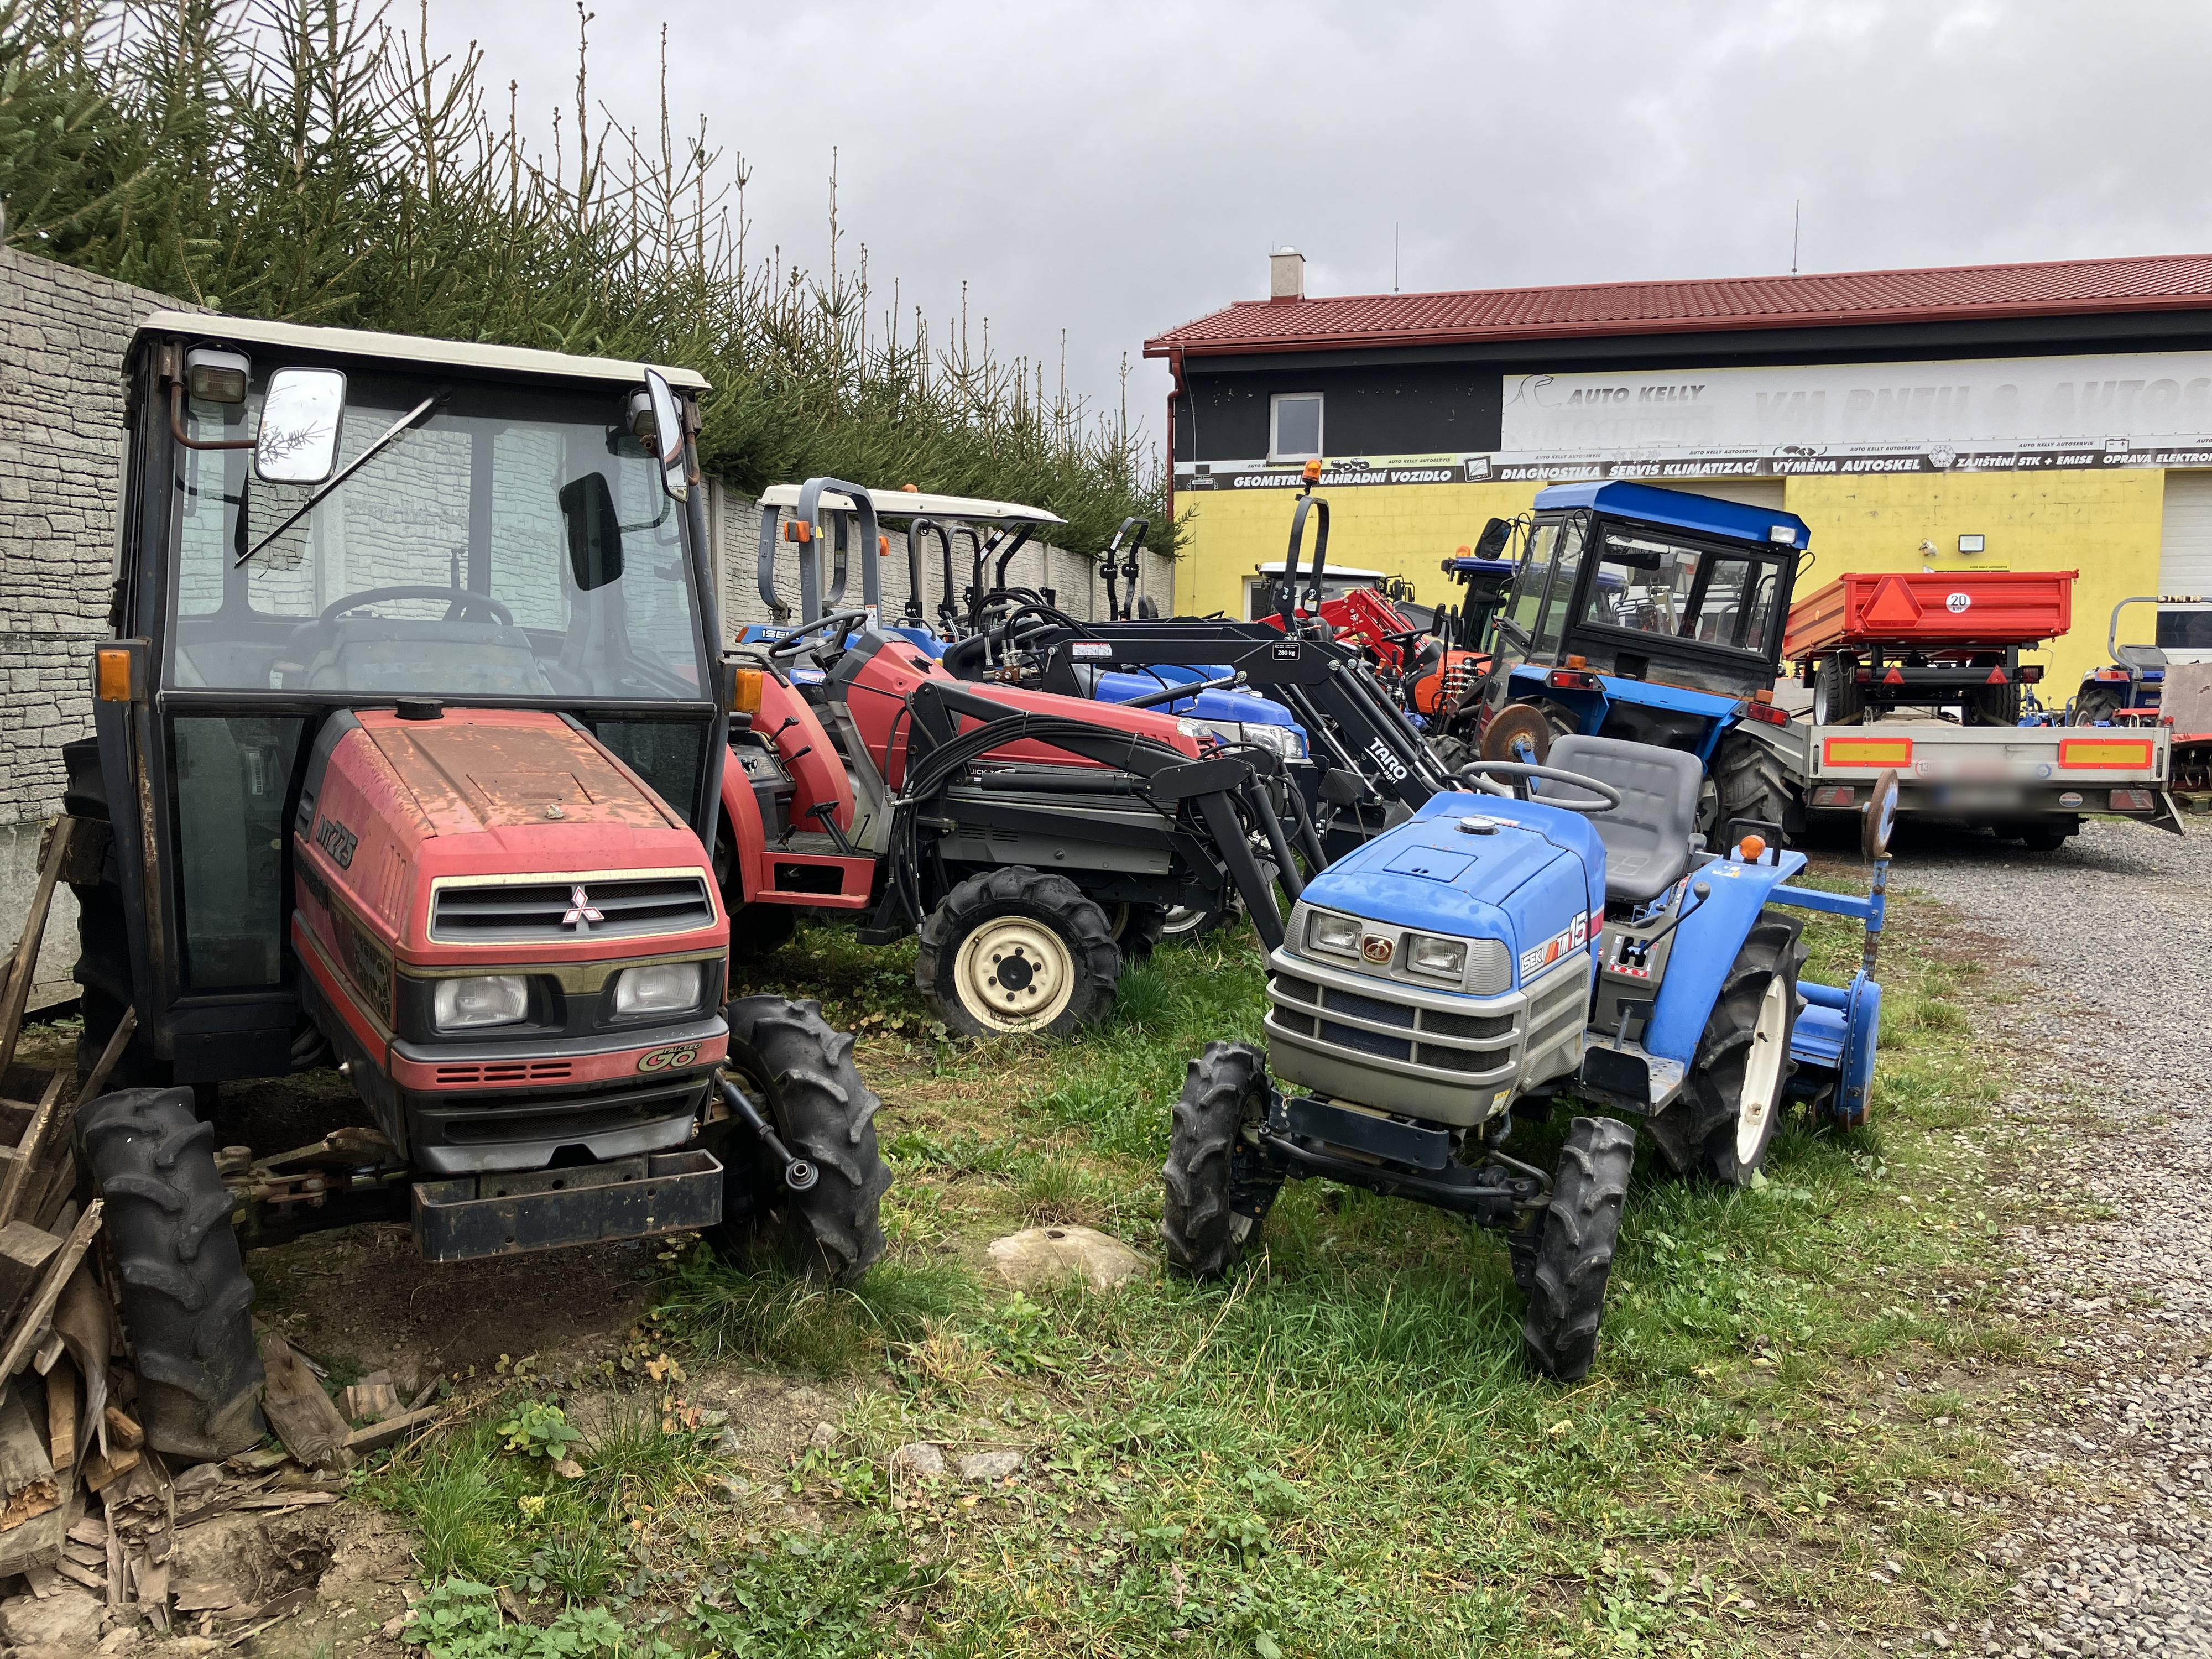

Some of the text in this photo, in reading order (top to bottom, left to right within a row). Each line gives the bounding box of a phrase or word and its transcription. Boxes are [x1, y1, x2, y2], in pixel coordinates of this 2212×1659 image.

[1567, 384, 1706, 405] AUTO KELLY
[1772, 458, 1921, 473] VÝMĚNA AUTOSKEL
[1955, 455, 2016, 467] ZAJIŠTĚNÍ
[2018, 456, 2042, 465] STK
[2056, 455, 2094, 465] EMISE
[2103, 454, 2151, 464] OPRAVA
[1500, 466, 1600, 480] DIAGNOSTIKA
[1609, 459, 1761, 477] SERVIS KLIMATIZACÍ
[1391, 470, 1452, 483] VOZIDLO
[1951, 595, 1966, 606] 20
[761, 629, 799, 640] ISE
[1370, 737, 1407, 780] TARO
[1384, 770, 1399, 784] agri
[316, 814, 358, 871] MT225
[1521, 947, 1544, 973] ISEKI
[663, 1042, 702, 1053] PALCEED
